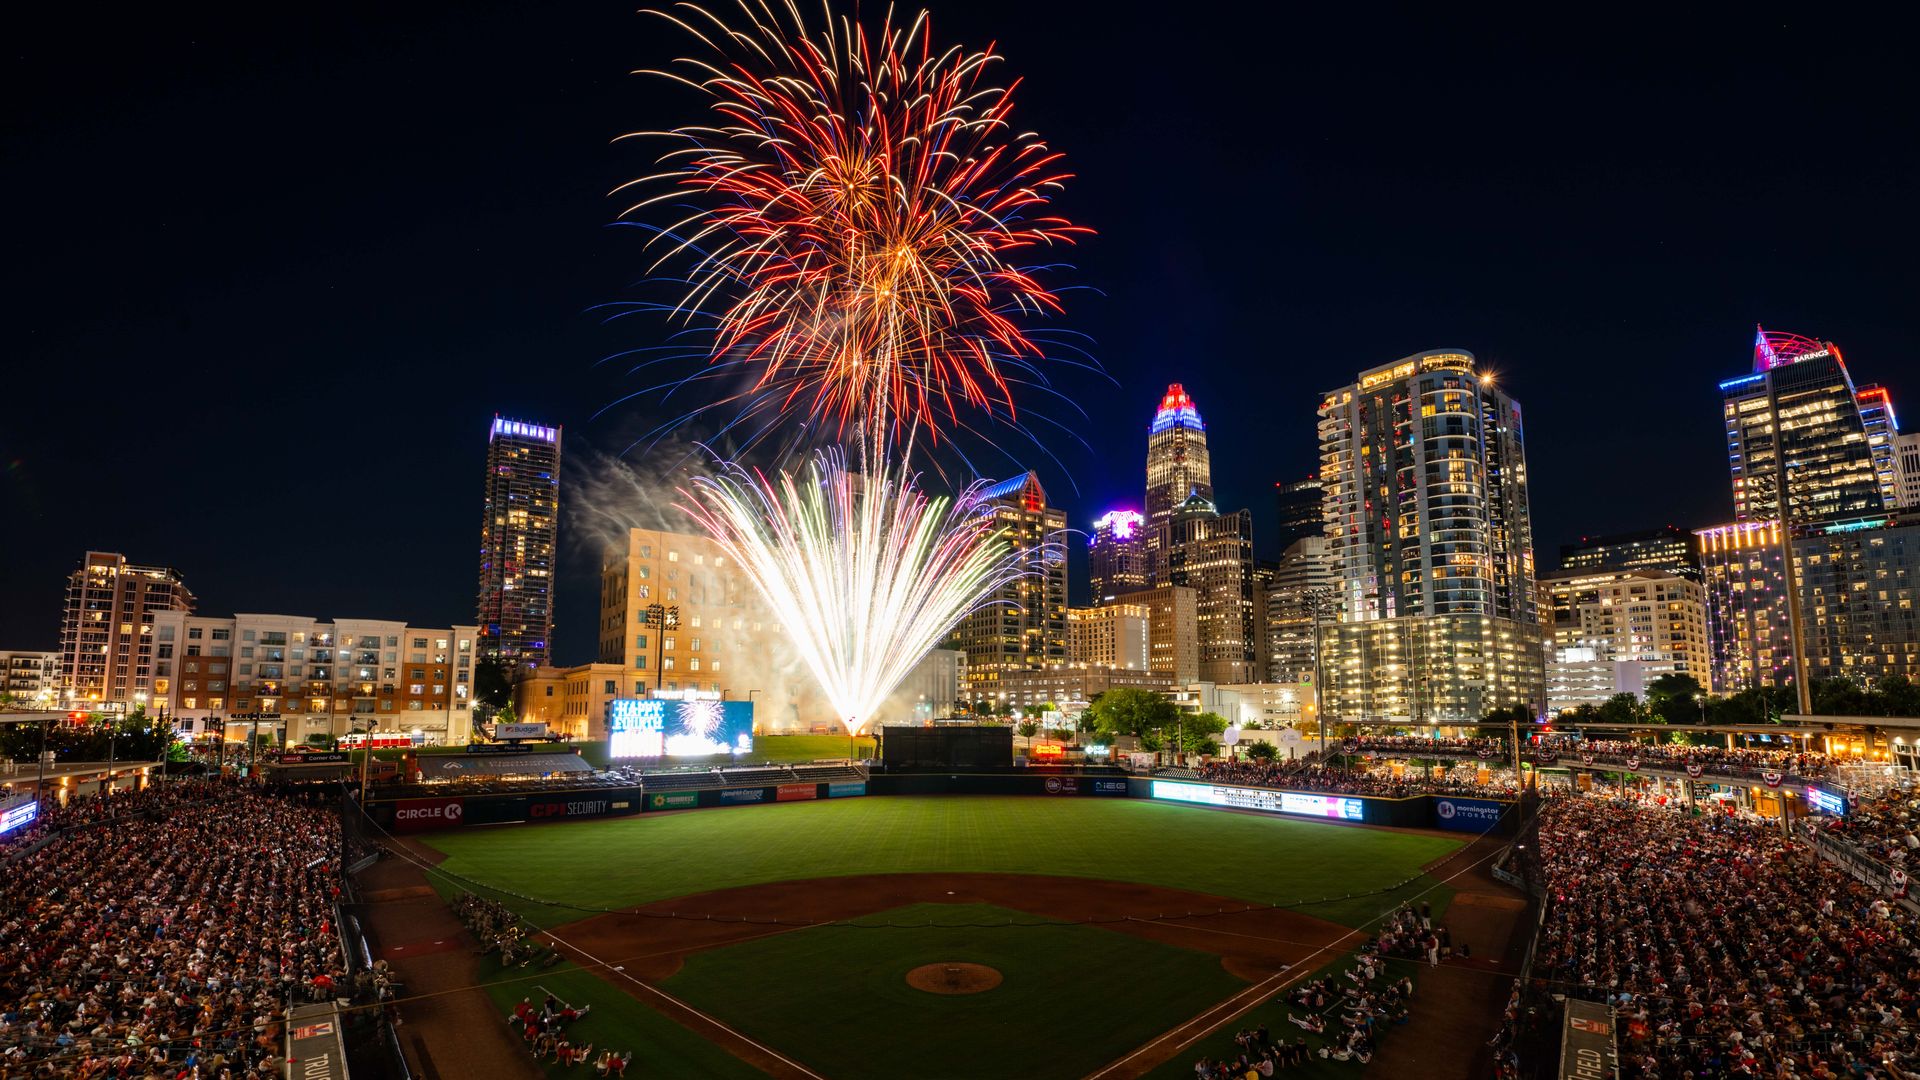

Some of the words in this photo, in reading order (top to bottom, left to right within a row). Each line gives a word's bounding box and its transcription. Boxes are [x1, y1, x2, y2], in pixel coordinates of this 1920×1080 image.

[1793, 350, 1829, 363] BARINGS
[617, 701, 661, 717] HAPPY
[614, 717, 663, 729] FOURTH
[515, 726, 539, 734] Budget
[396, 807, 441, 820] CIRCLE
[445, 804, 462, 819] K
[529, 803, 566, 817] CPI
[567, 800, 607, 815] SECURITY
[1456, 805, 1499, 815] morningstar
[1456, 812, 1500, 820] STORAGE
[1576, 1048, 1602, 1079] FIELD
